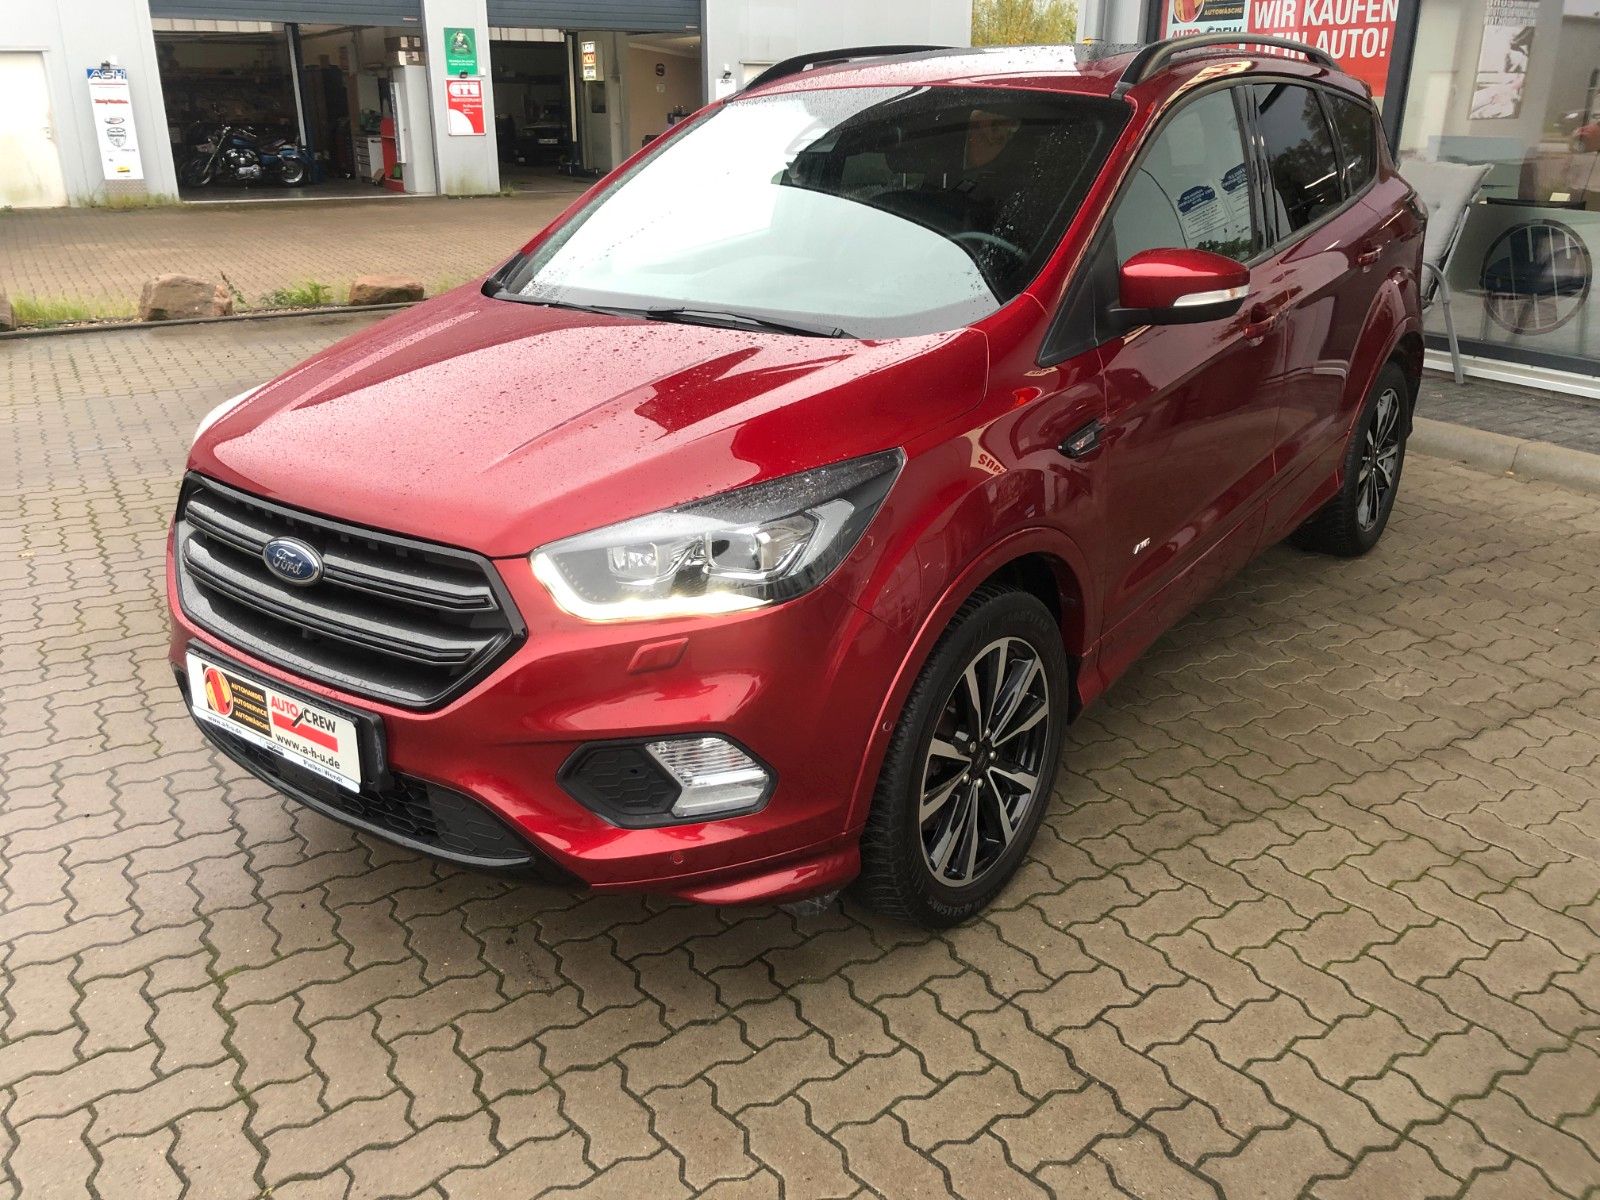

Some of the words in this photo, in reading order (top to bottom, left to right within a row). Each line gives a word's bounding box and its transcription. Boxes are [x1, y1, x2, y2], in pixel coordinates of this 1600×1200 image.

[1254, 0, 1297, 29] WIR
[1302, 0, 1400, 26] KAUFEN
[1315, 27, 1389, 59] AUTO!
[272, 547, 304, 575] Ford
[271, 695, 299, 718] AUTO
[303, 708, 336, 733] CREW
[276, 734, 341, 770] www.a-h-u.de
